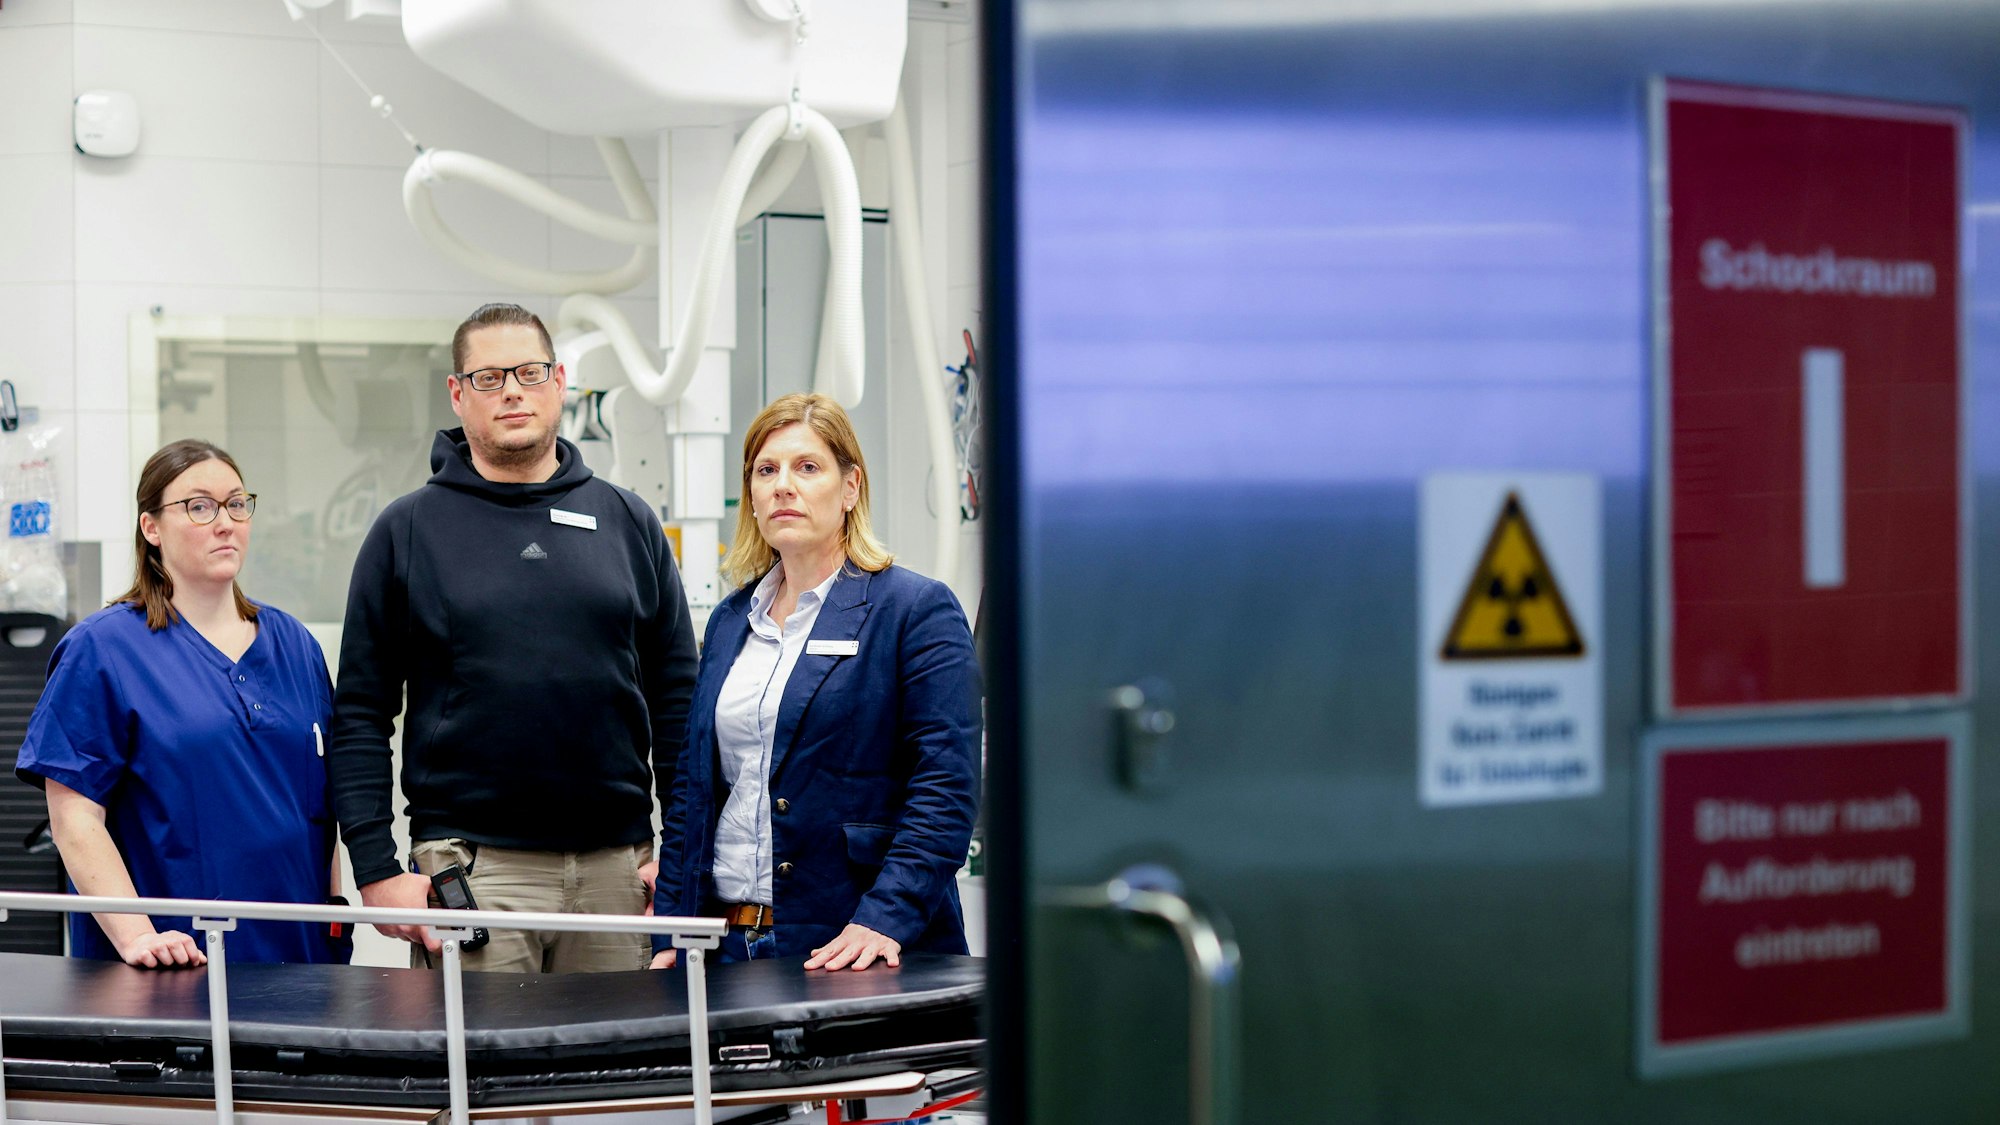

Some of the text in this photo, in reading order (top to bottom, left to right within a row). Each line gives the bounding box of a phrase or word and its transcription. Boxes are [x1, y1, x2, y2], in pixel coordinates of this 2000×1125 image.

[1701, 239, 1936, 296] Schockraum
[1696, 791, 1920, 843] Bitte nur nach
[1702, 857, 1915, 902] Aufforderung
[1736, 924, 1881, 967] eintreten
